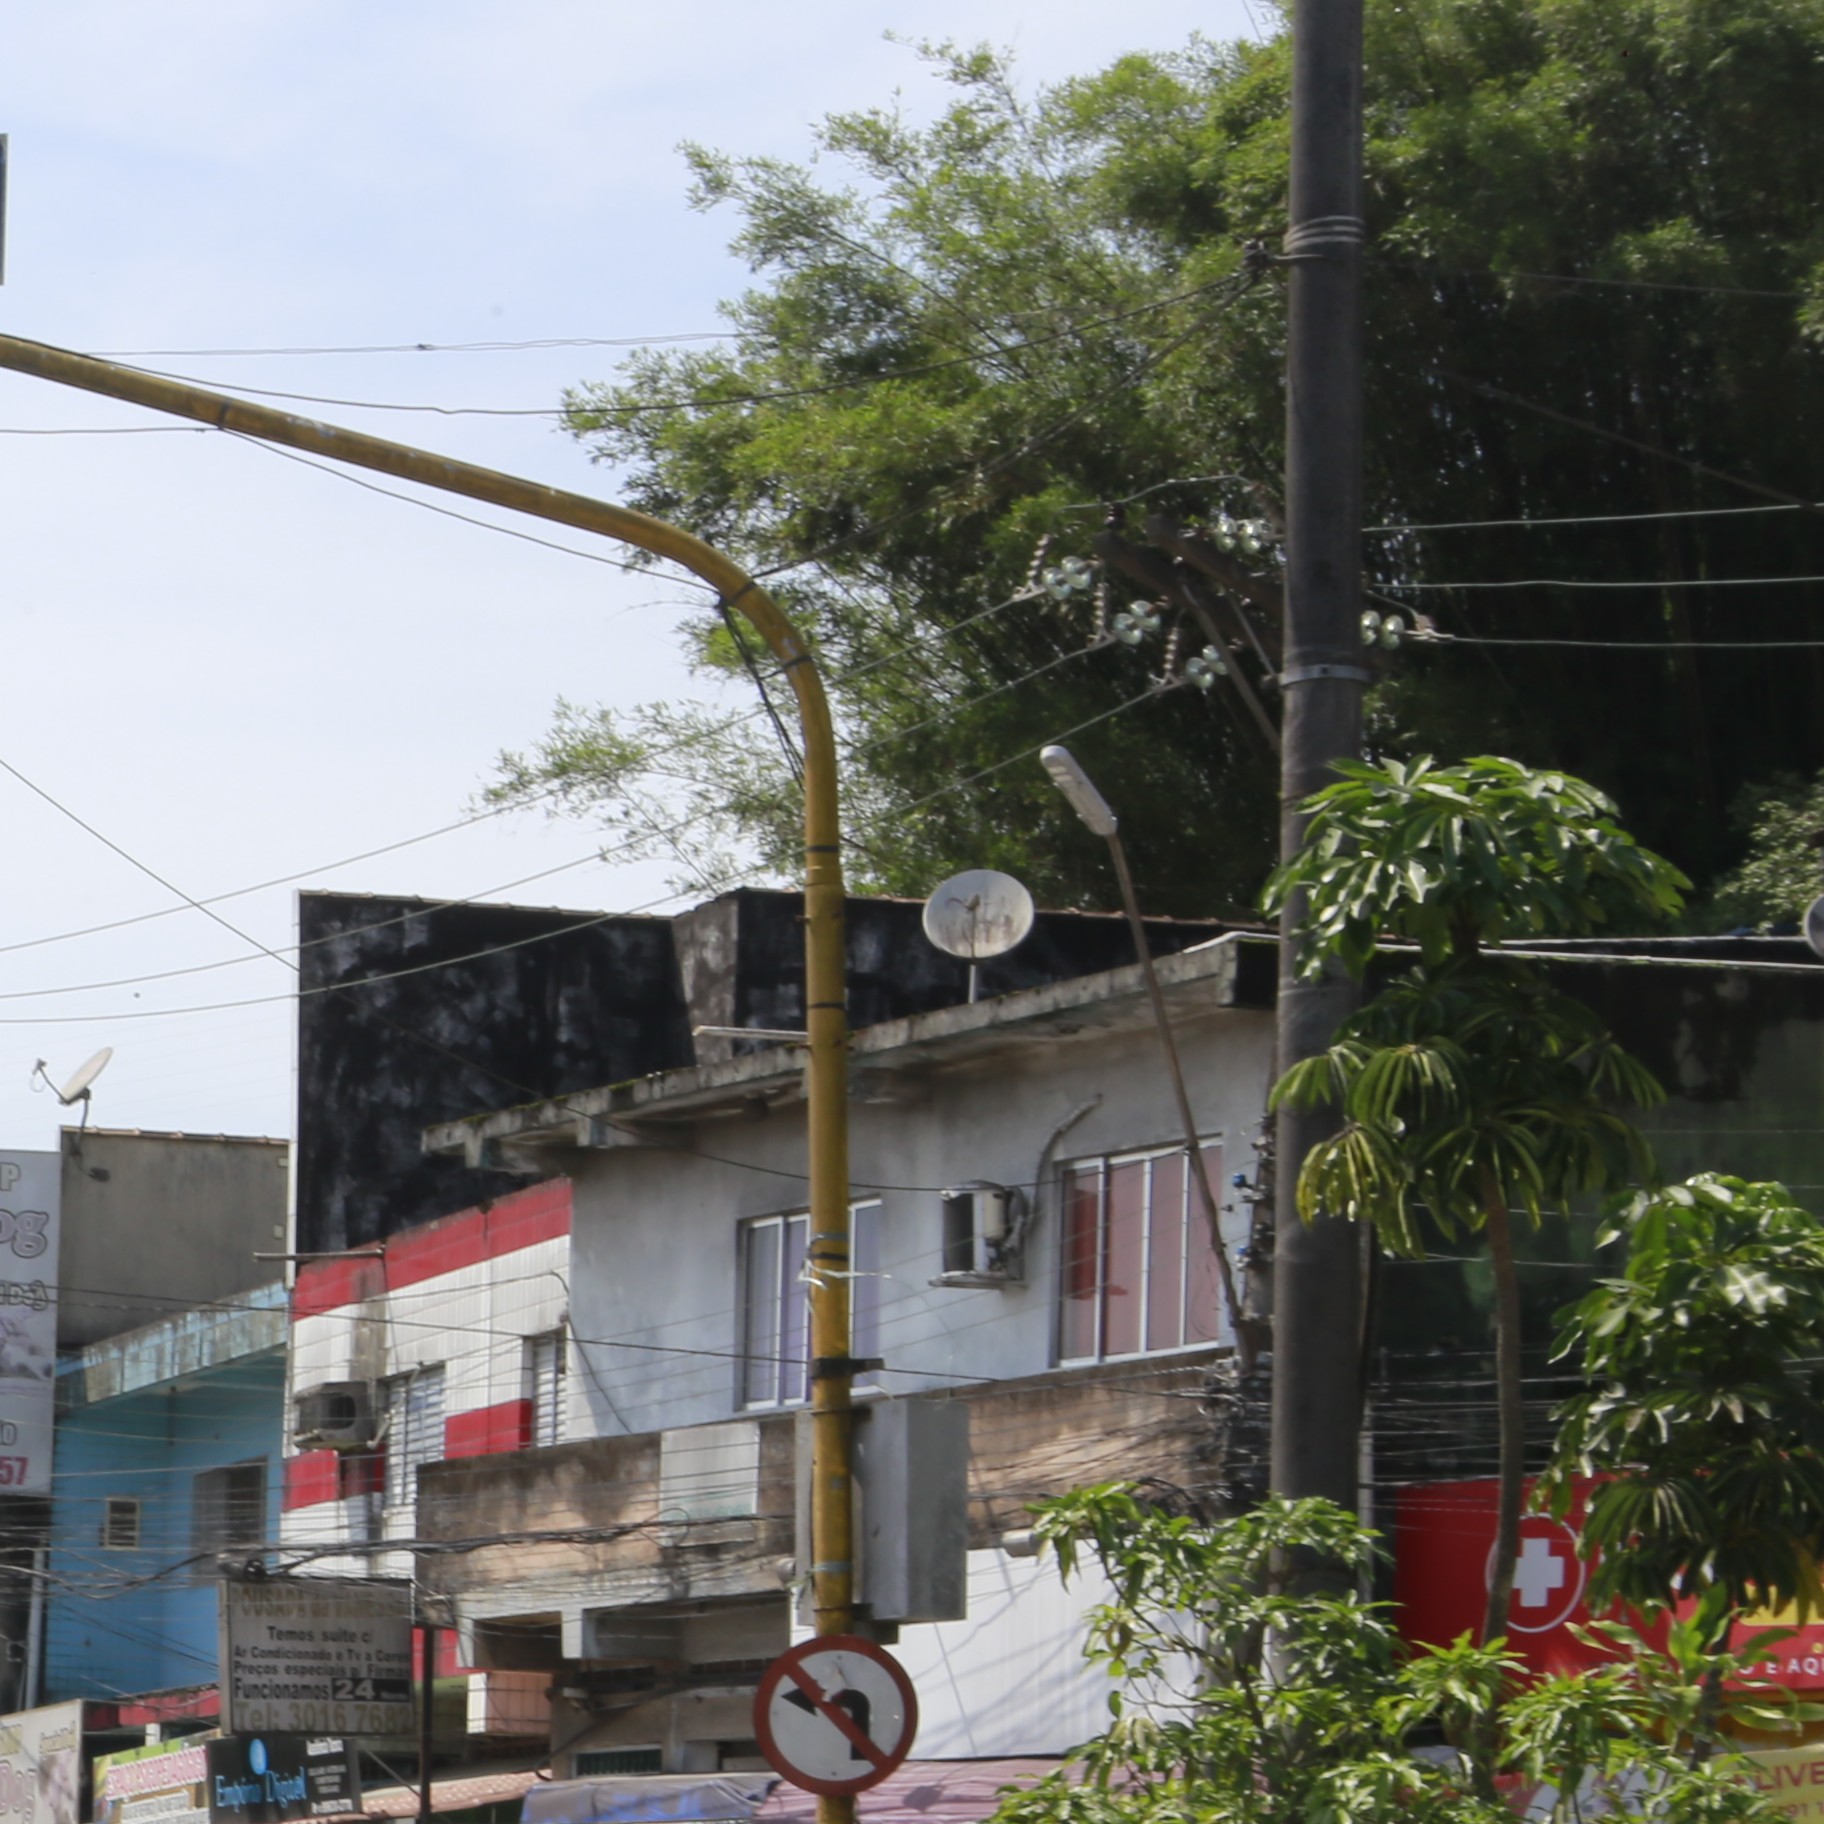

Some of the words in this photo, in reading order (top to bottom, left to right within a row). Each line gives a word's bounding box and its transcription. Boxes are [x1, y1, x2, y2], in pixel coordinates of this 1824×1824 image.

[266, 1625, 314, 1642] Temos
[234, 1645, 246, 1658] Ar
[251, 1645, 332, 1662] Condicionado
[233, 1660, 279, 1679] Preços
[284, 1663, 346, 1681] especiais
[234, 1678, 330, 1700] Funcionamos
[334, 1679, 375, 1700] 24
[234, 1702, 280, 1731] Tel:
[289, 1703, 348, 1732] 3016
